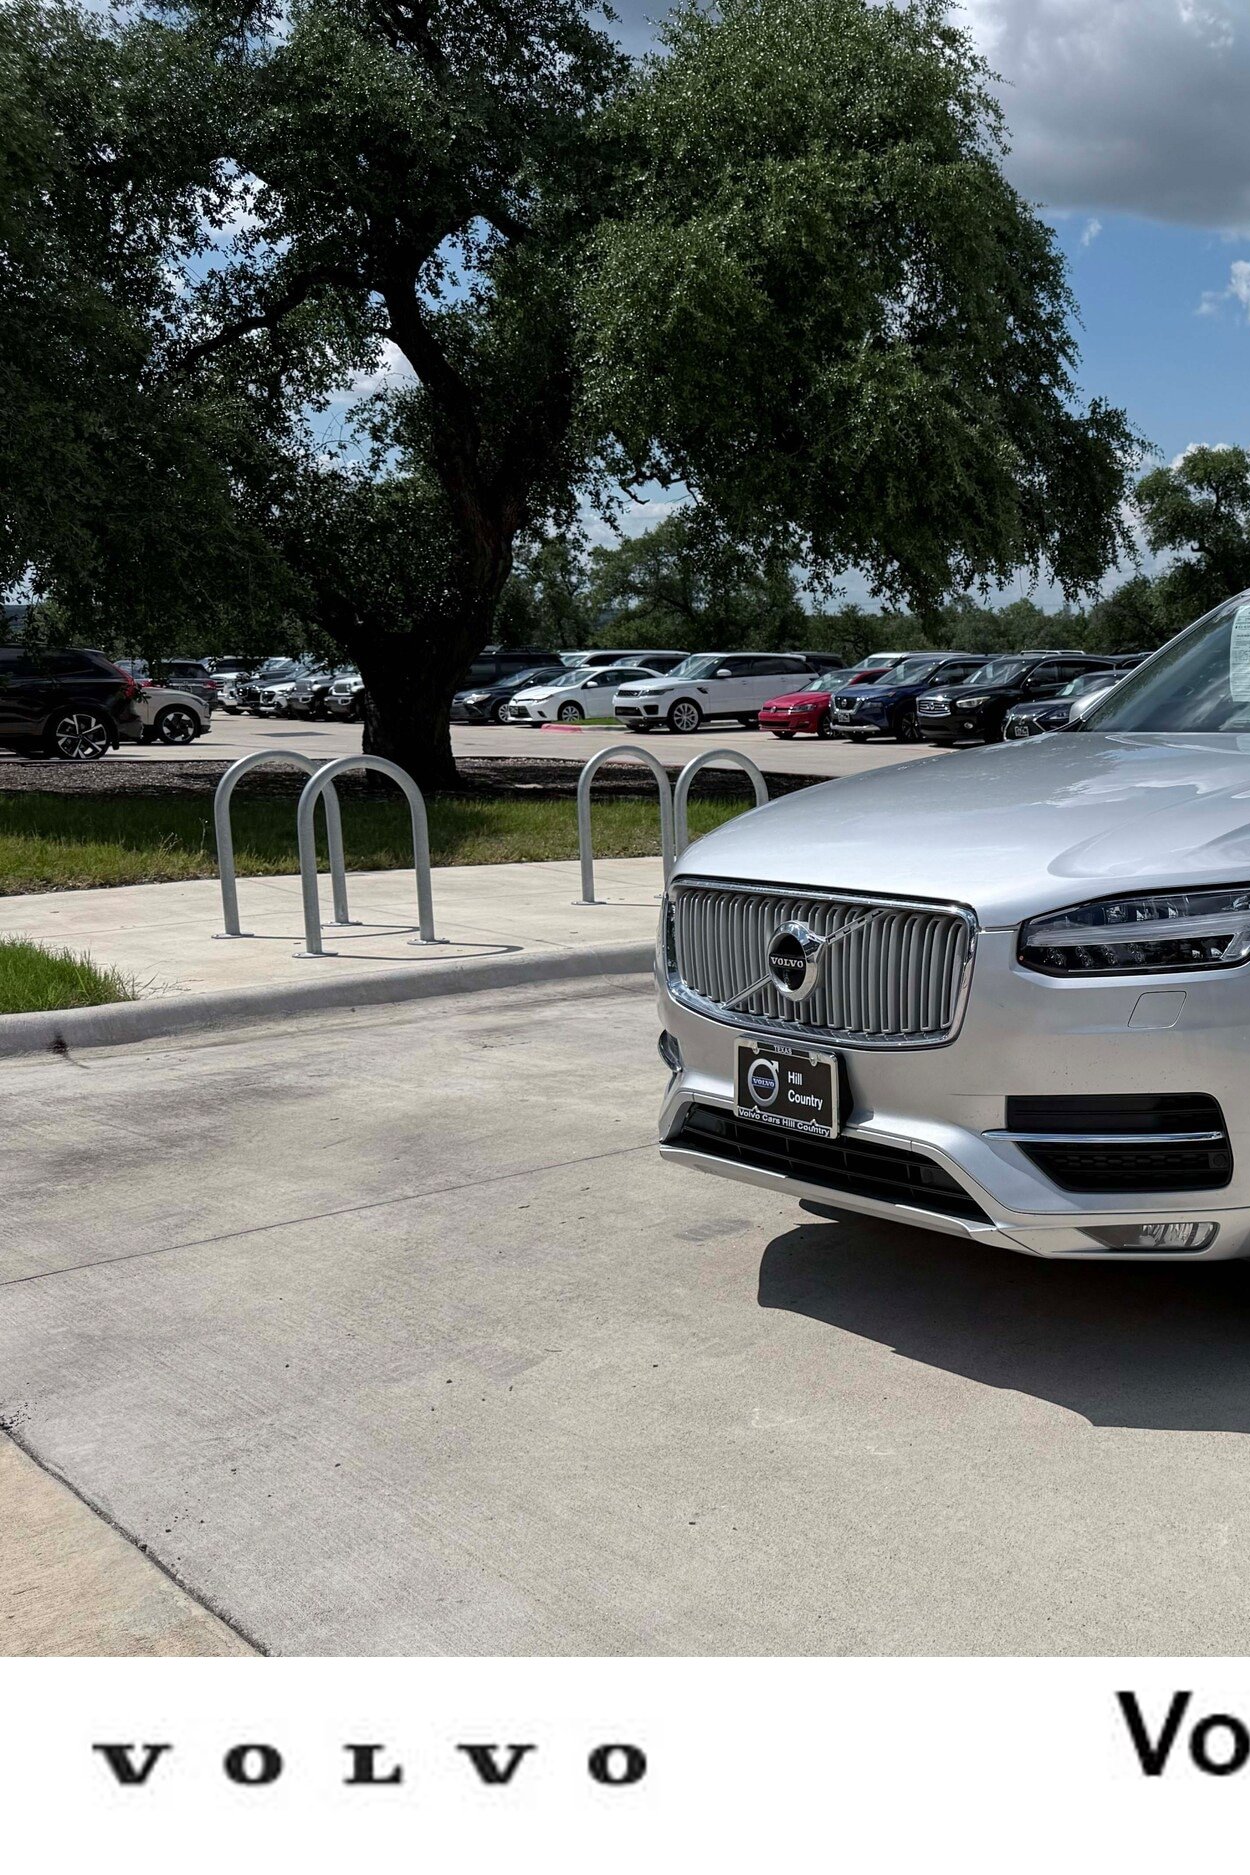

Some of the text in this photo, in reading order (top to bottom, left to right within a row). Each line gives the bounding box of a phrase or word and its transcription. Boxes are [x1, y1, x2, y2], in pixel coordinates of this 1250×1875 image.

[771, 956, 804, 968] VOLVO
[774, 1045, 793, 1055] TEXAS
[752, 1078, 775, 1087] VOLVO
[787, 1071, 803, 1085] Hill
[787, 1089, 823, 1111] Country
[739, 1108, 830, 1138] Volvo Cars Hill Country
